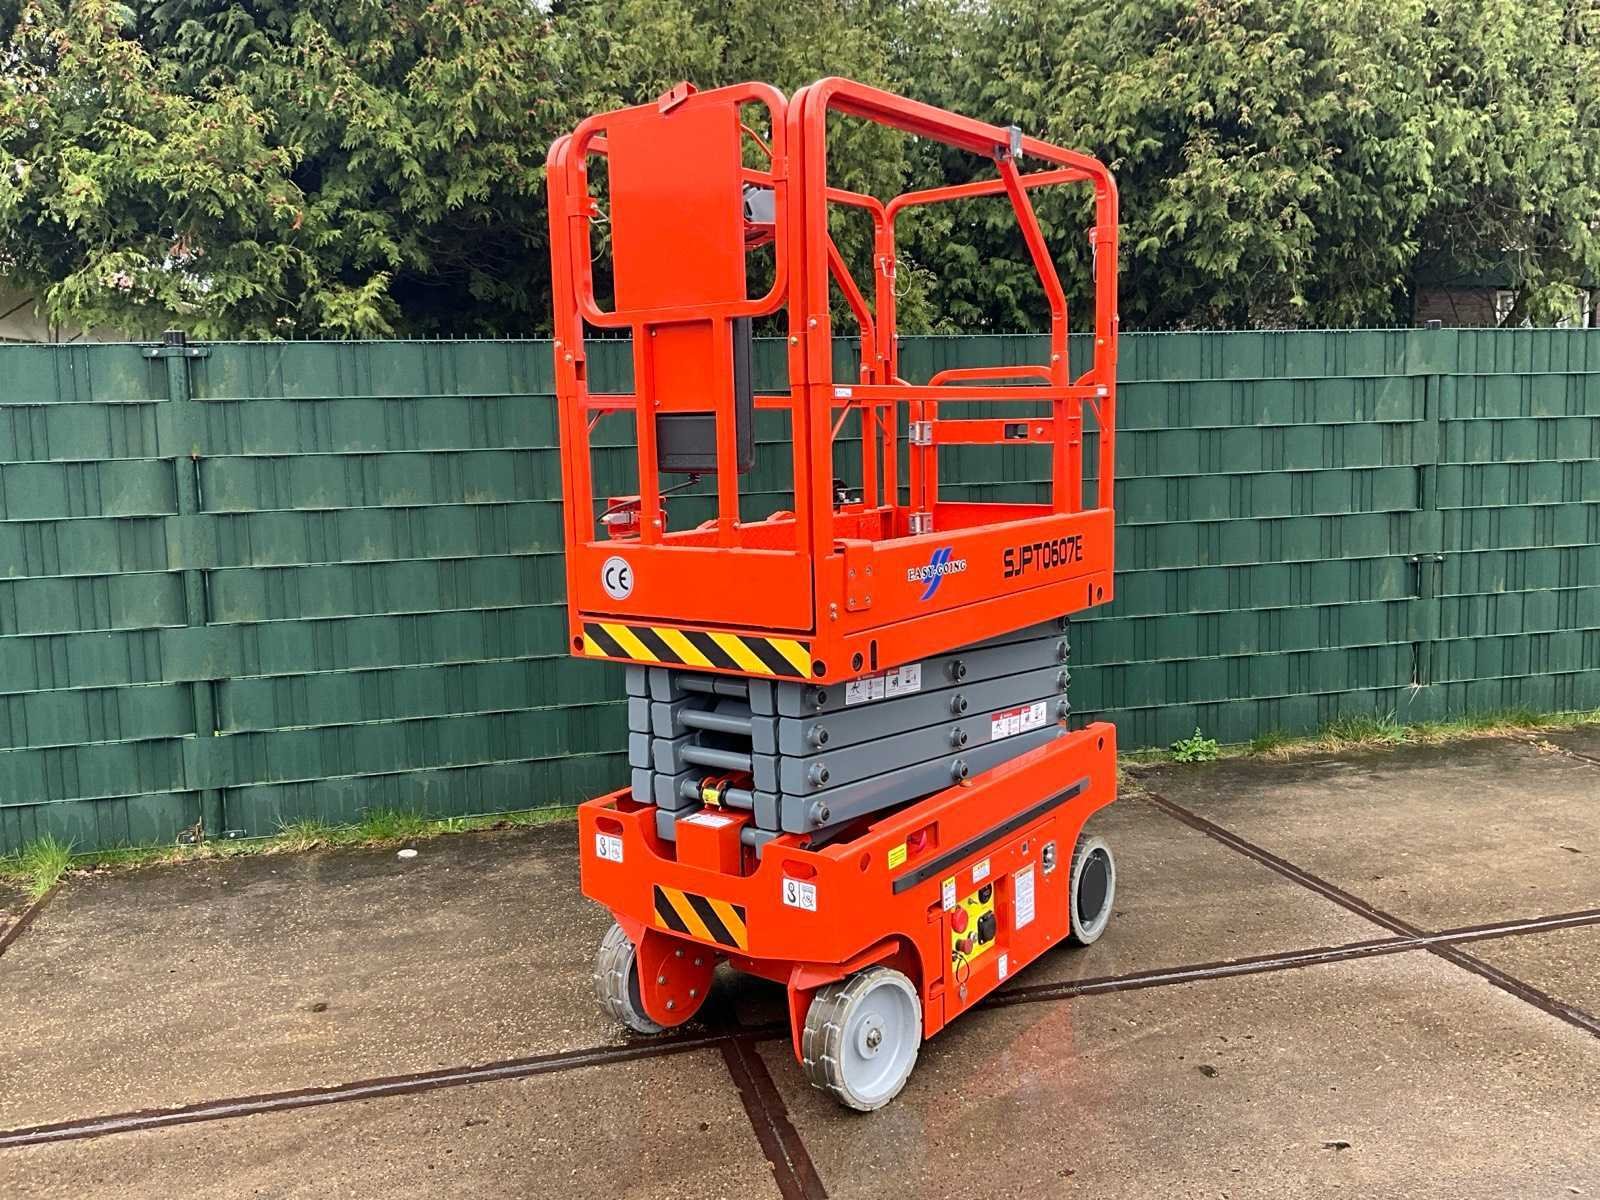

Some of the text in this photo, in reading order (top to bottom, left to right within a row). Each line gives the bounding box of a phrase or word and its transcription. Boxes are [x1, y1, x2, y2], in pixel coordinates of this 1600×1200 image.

[1004, 535, 1083, 578] SJPT0607E
[606, 567, 629, 590] CE
[908, 559, 967, 581] EASY-GOING
